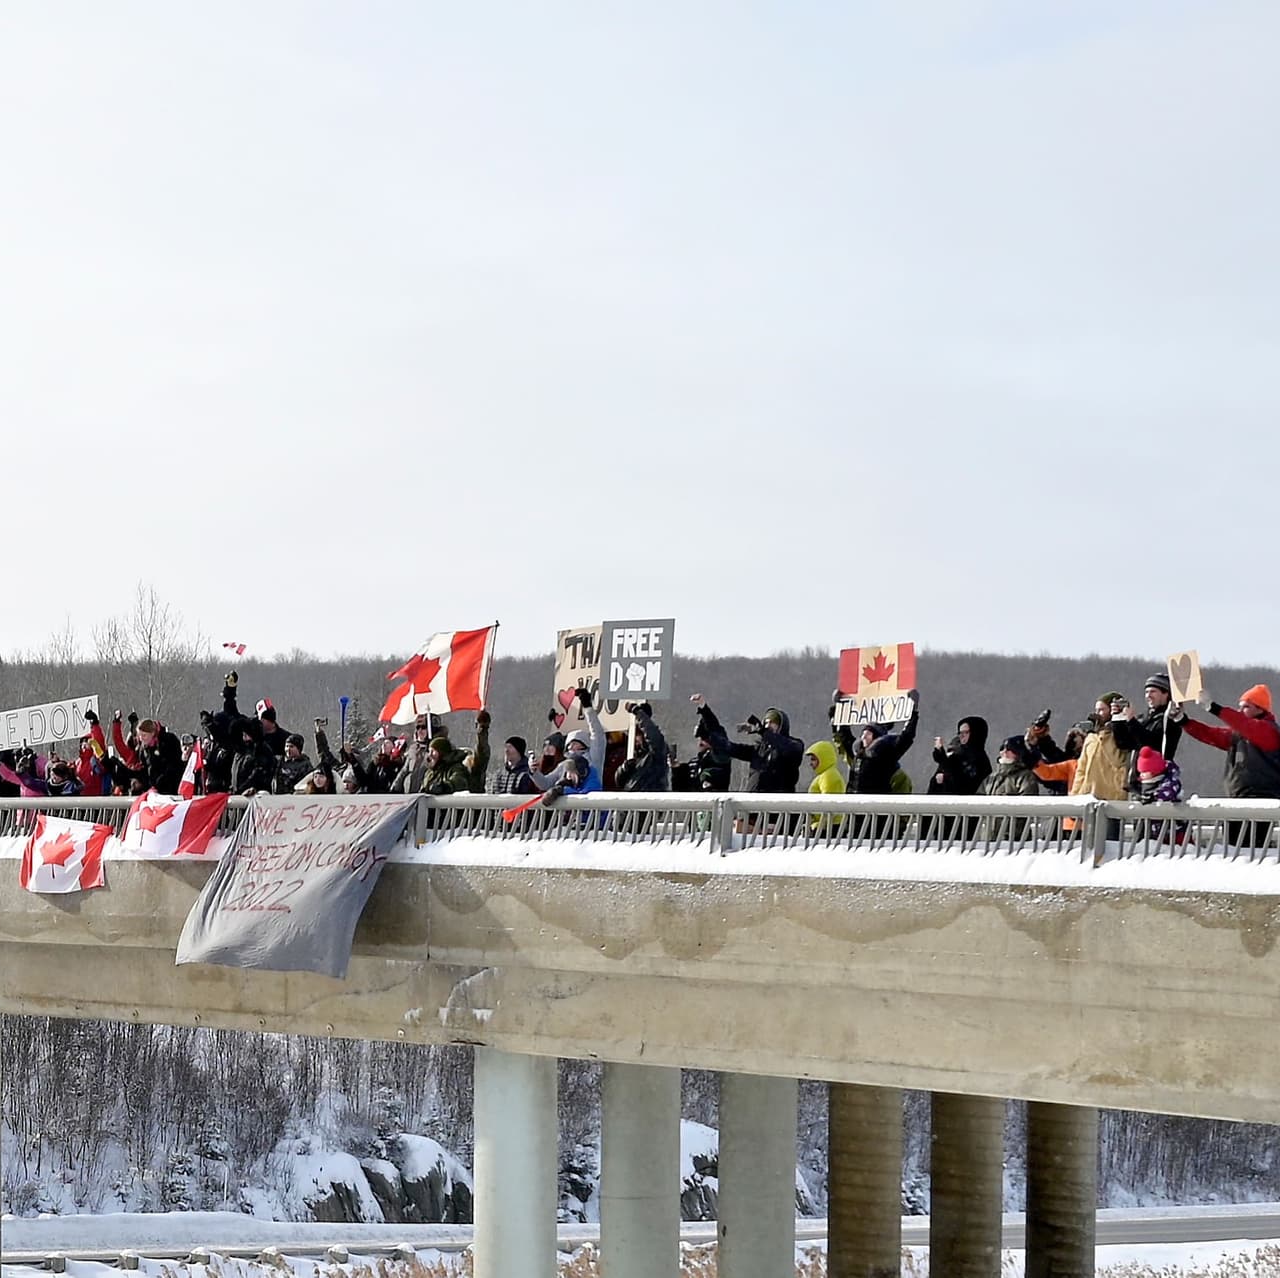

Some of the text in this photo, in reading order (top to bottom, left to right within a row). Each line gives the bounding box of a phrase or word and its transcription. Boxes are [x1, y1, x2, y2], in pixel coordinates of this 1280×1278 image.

[611, 627, 664, 658] FREE
[888, 696, 913, 721] YOU
[294, 801, 404, 833] SUPPORT
[221, 879, 304, 913] 2022
